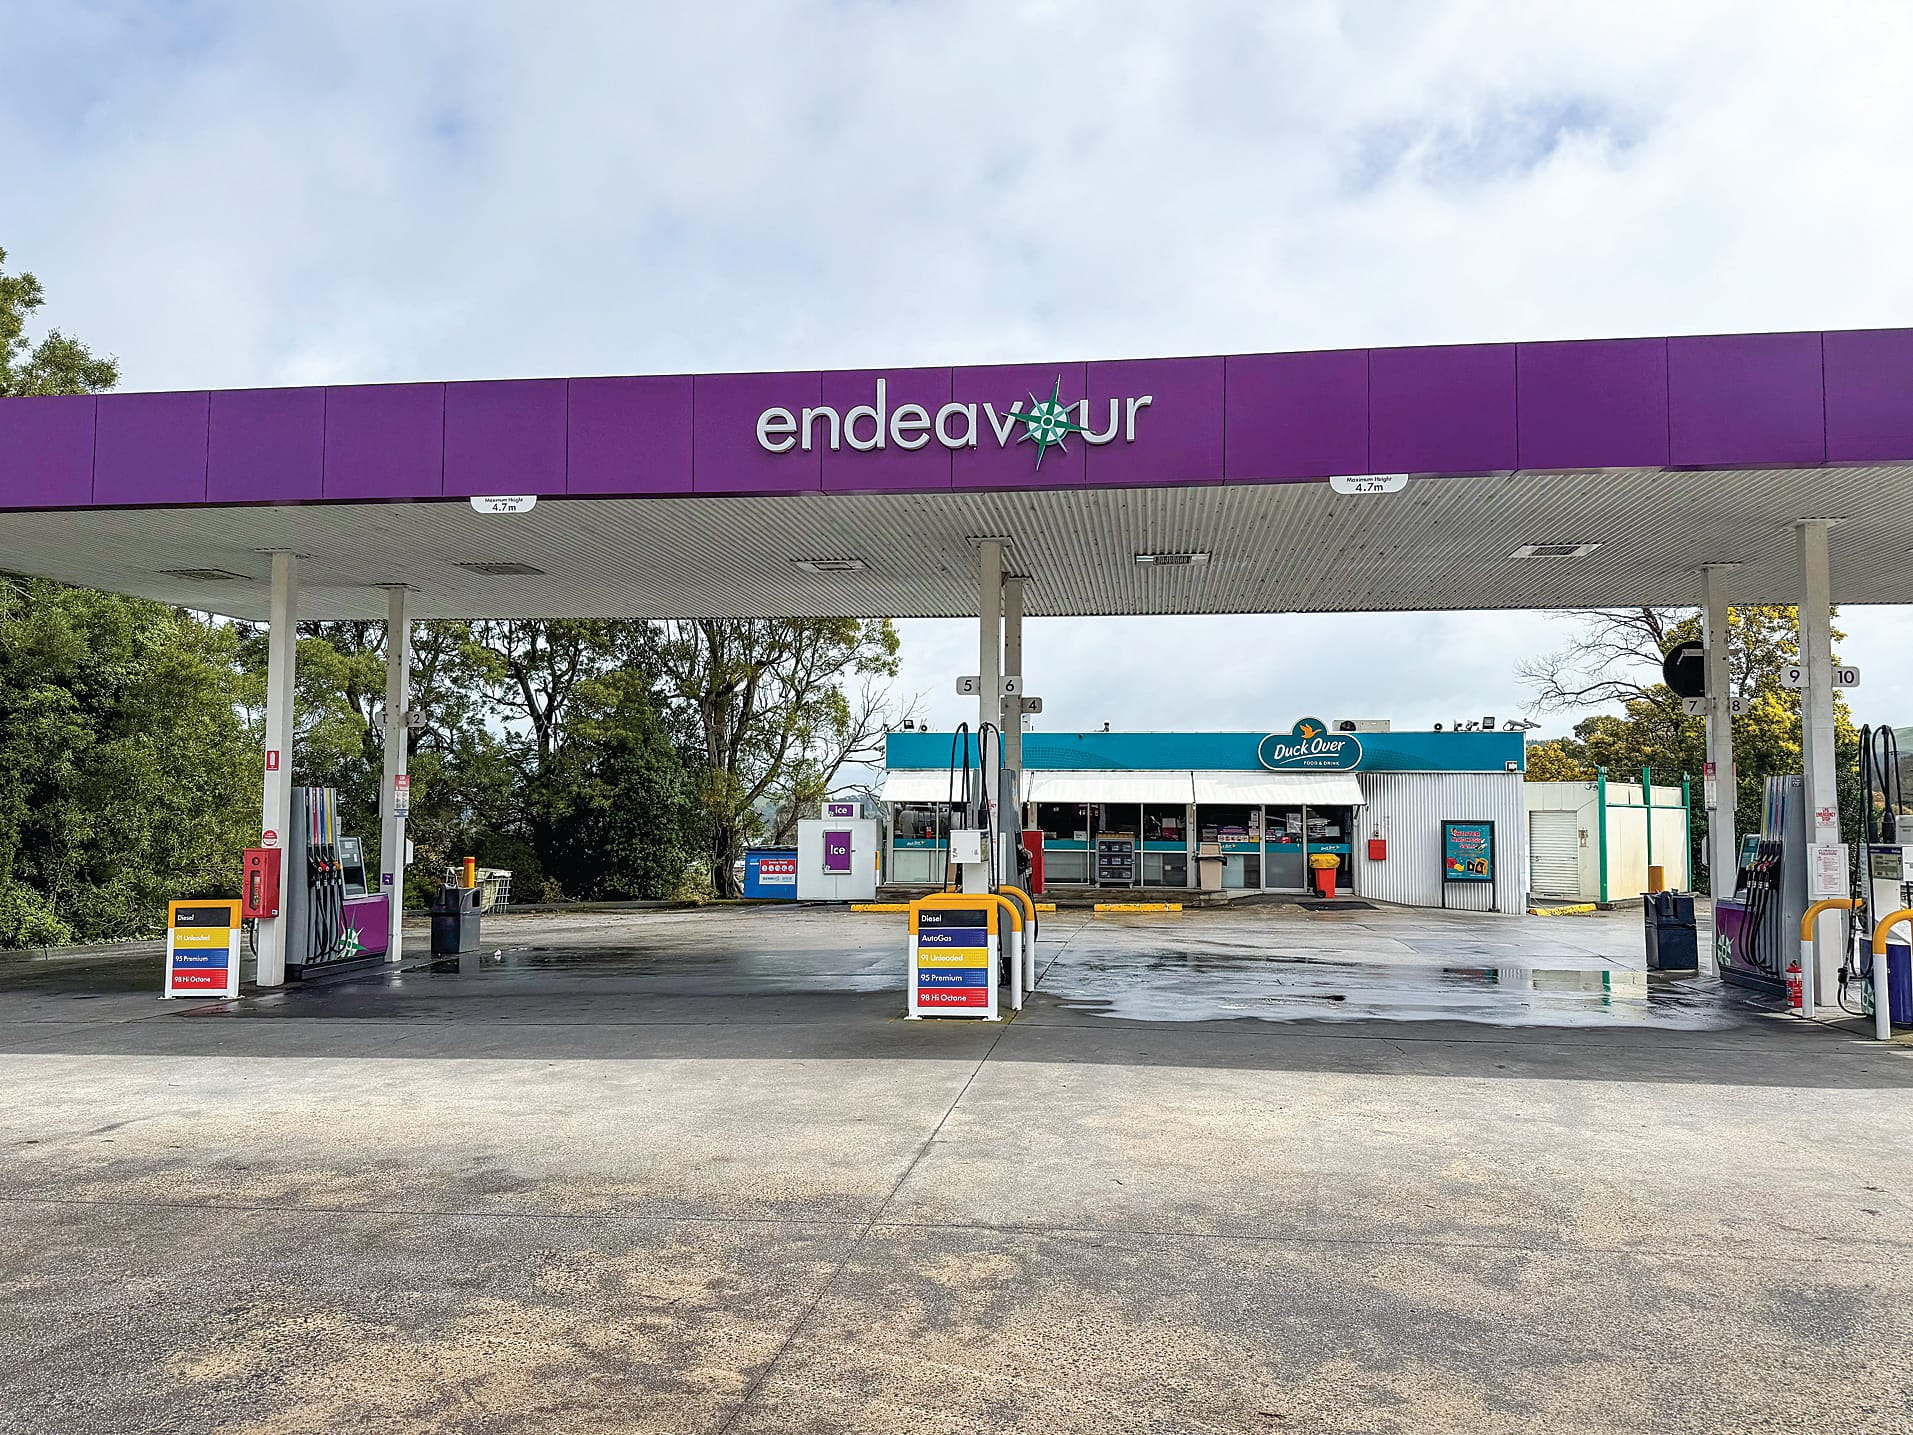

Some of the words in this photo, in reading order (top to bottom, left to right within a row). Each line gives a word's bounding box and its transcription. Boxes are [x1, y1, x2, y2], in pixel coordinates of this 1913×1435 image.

[756, 376, 1153, 466] endeavour
[1355, 482, 1384, 492] 4.7m
[1789, 670, 1800, 683] 9
[1837, 670, 1854, 684] 10
[963, 679, 972, 692] 5
[1005, 679, 1015, 692] 6
[1028, 700, 1037, 710] 4
[1688, 700, 1698, 712] 7
[1732, 700, 1741, 712] 8
[413, 714, 420, 723] 2
[1274, 739, 1309, 760] Duck
[1311, 737, 1346, 754] Over
[835, 806, 848, 814] Ice
[830, 844, 846, 855] Ice
[921, 914, 942, 922] Diesel
[921, 934, 952, 942] AutoGas
[920, 974, 930, 982] 95
[932, 973, 963, 982] Premium
[940, 994, 967, 1002] Octane
